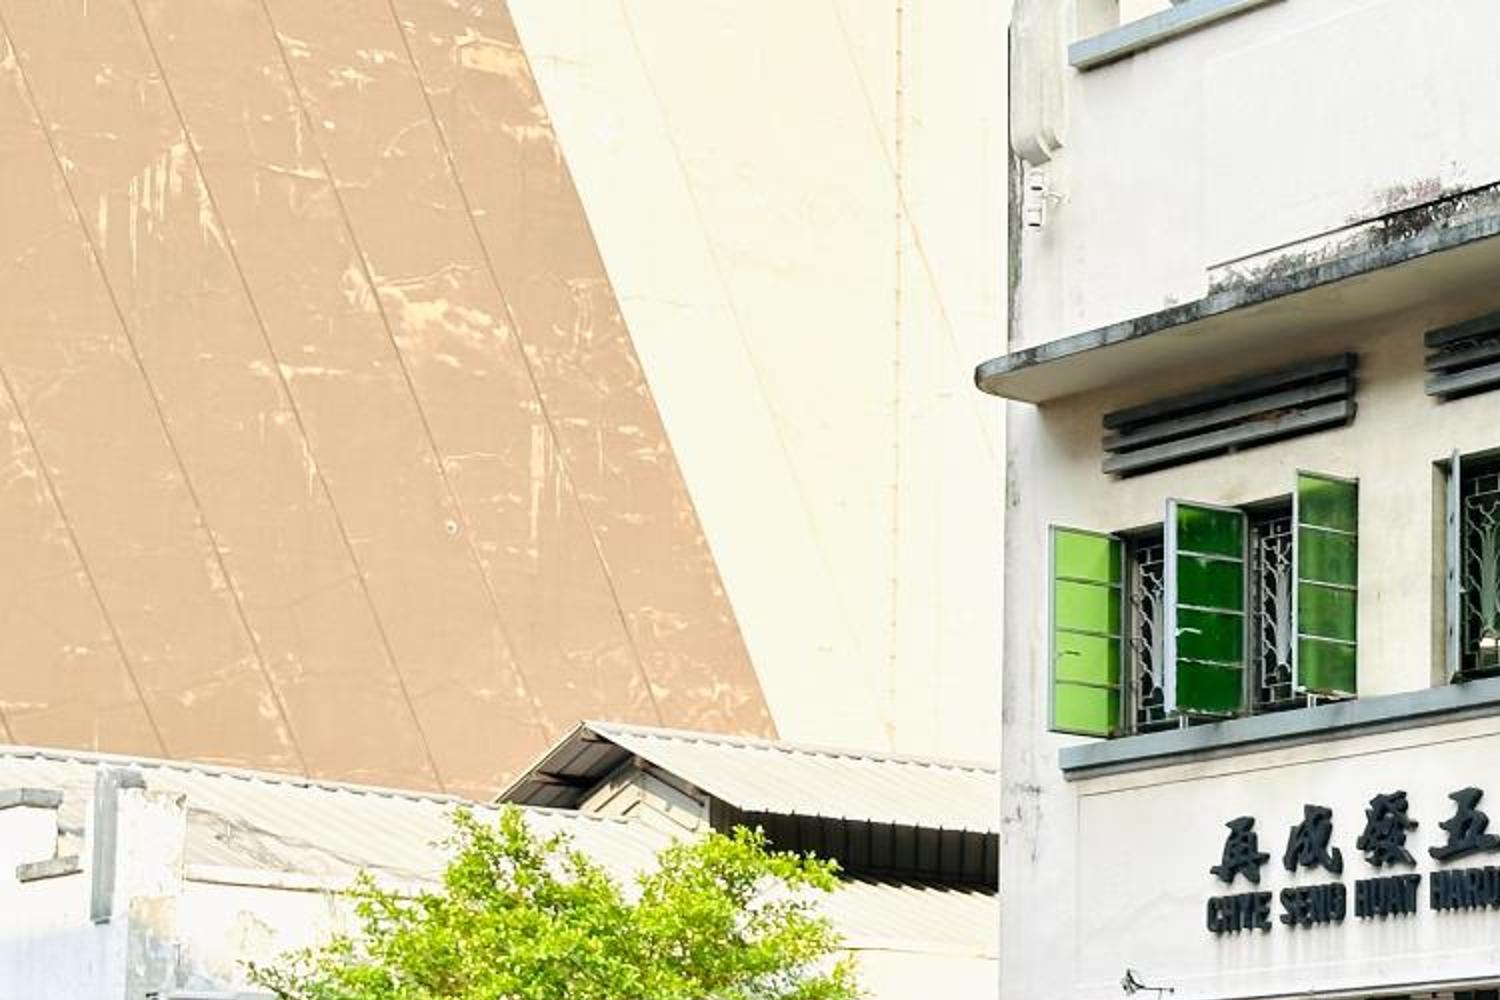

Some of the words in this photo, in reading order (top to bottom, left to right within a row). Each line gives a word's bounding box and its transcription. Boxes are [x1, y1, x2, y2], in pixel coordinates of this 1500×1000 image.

[1207, 891, 1273, 934] CHYE
[1279, 882, 1347, 928] SENG
[1354, 873, 1422, 920] HUAT
